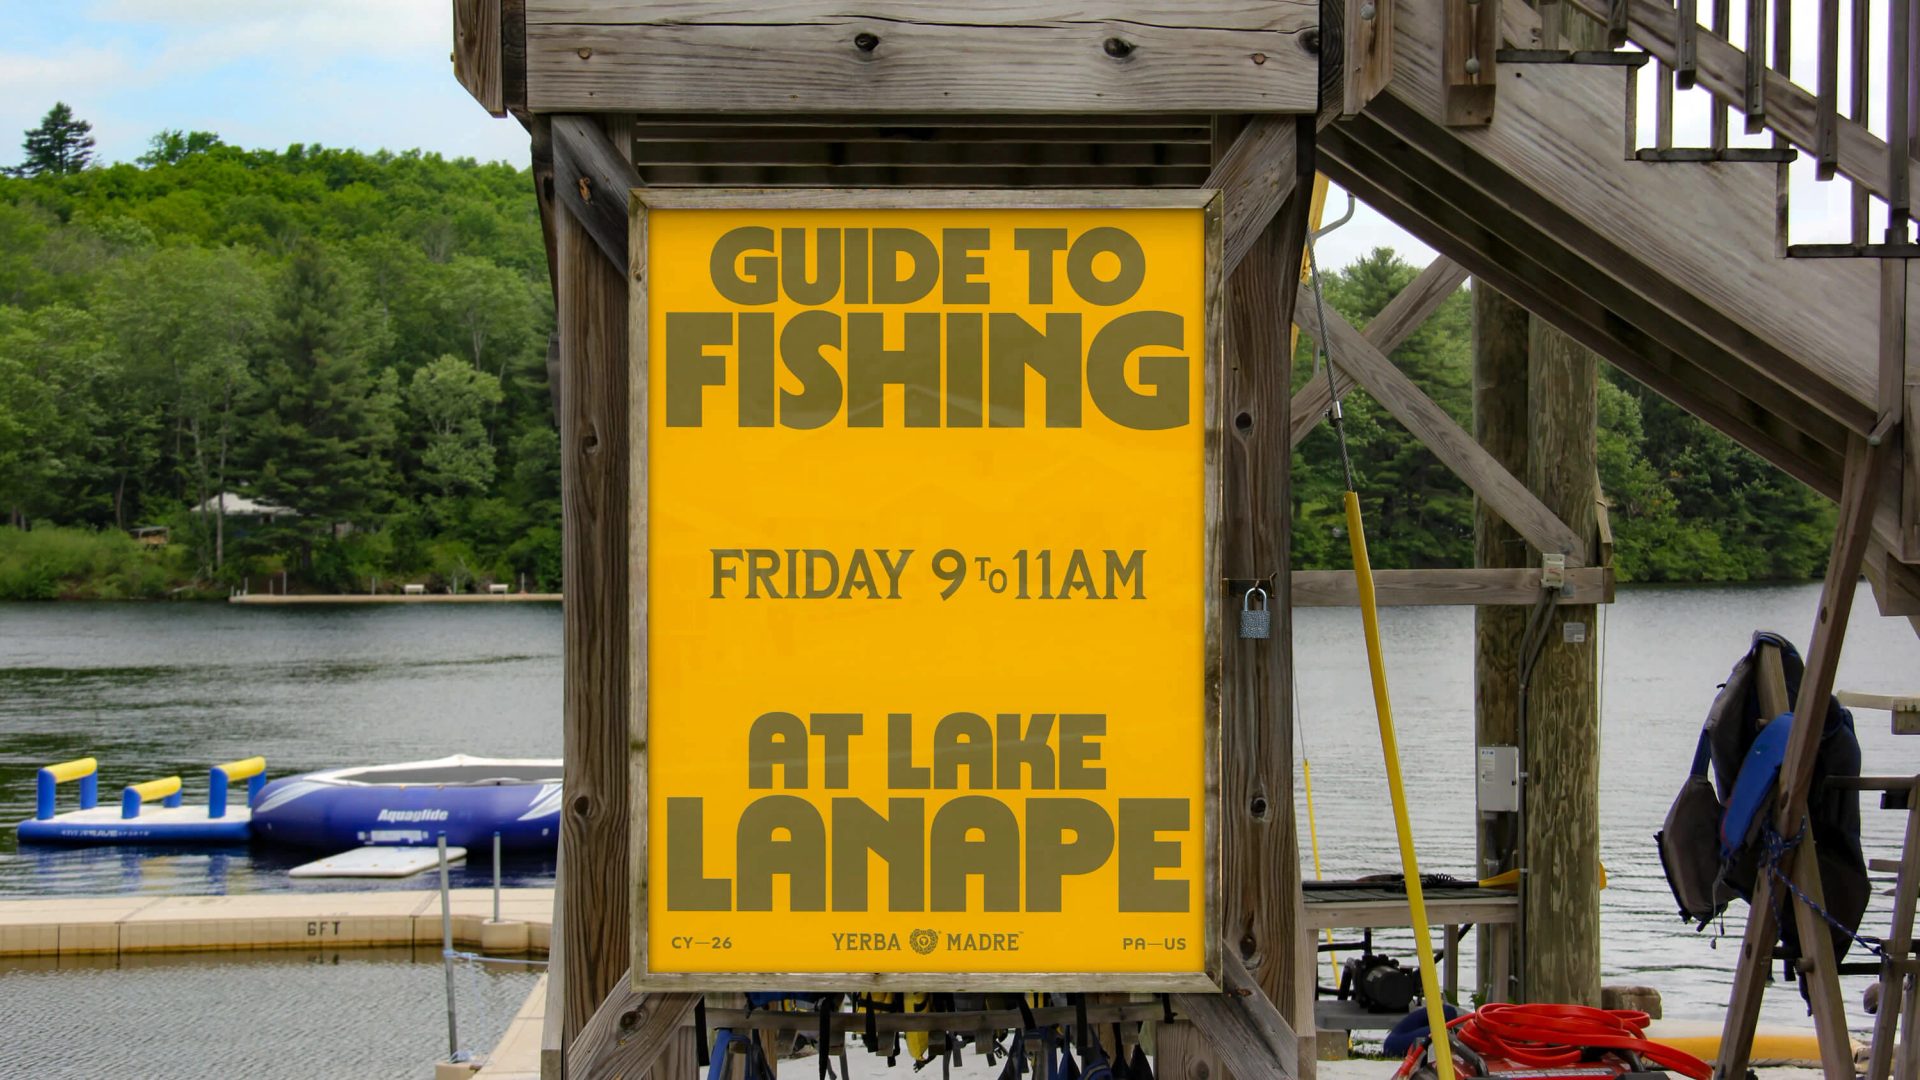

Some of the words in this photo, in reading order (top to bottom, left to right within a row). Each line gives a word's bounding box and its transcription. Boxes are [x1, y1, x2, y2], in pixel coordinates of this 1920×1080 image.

[710, 226, 990, 306] GUIDE
[1014, 226, 1146, 306] TO
[666, 310, 1190, 431] FISHING
[710, 548, 914, 600] FRIDAY
[931, 549, 967, 601] 9
[1013, 549, 1147, 600] 11AM
[749, 712, 863, 789] AT
[888, 712, 1106, 790] LAKE
[377, 808, 449, 823] Aquaglide
[667, 795, 1190, 913] LANAPE
[832, 933, 901, 951] YERBA
[947, 933, 1019, 951] MADRE
